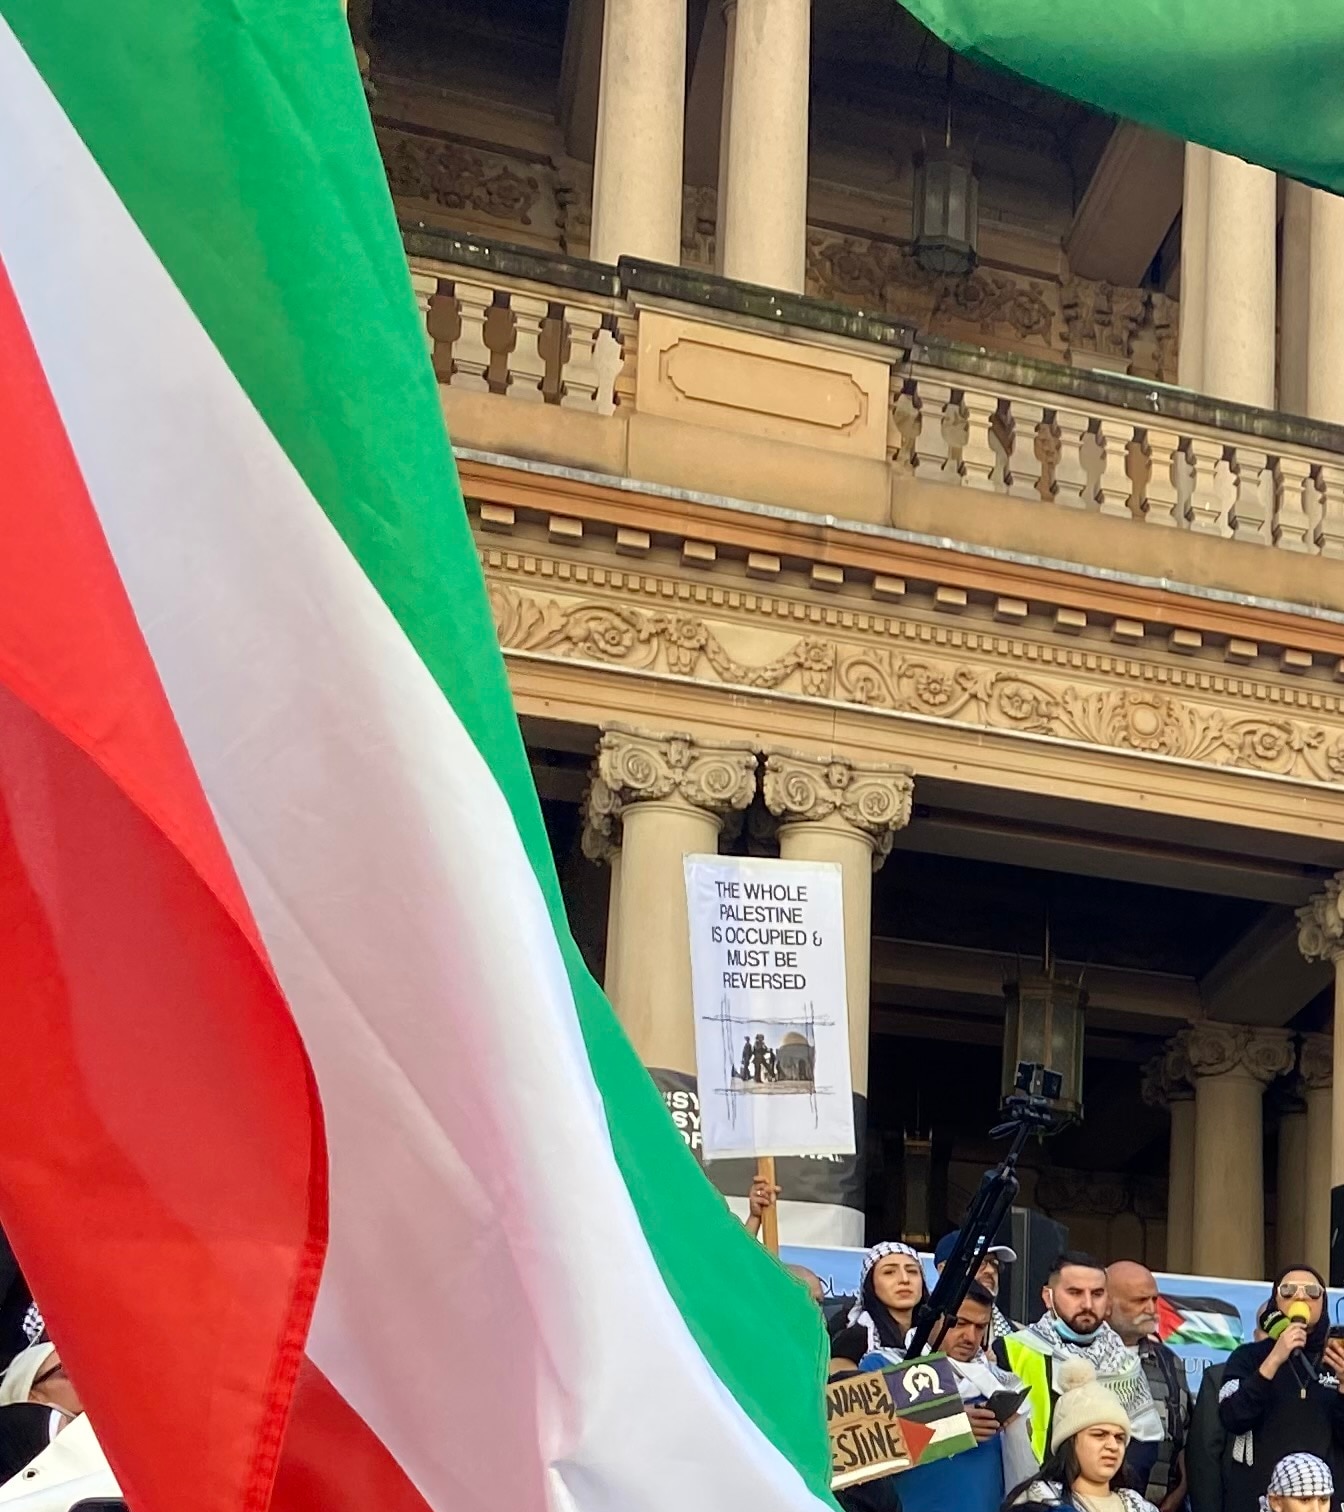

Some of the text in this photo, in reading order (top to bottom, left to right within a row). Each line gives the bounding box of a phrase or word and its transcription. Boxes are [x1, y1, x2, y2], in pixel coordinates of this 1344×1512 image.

[714, 880, 809, 902] THE WHOLE
[719, 903, 804, 924] PALESTINE
[711, 926, 823, 947] IS OCCUPIED &
[727, 949, 798, 968] MUST BE
[722, 971, 807, 990] REVERSED
